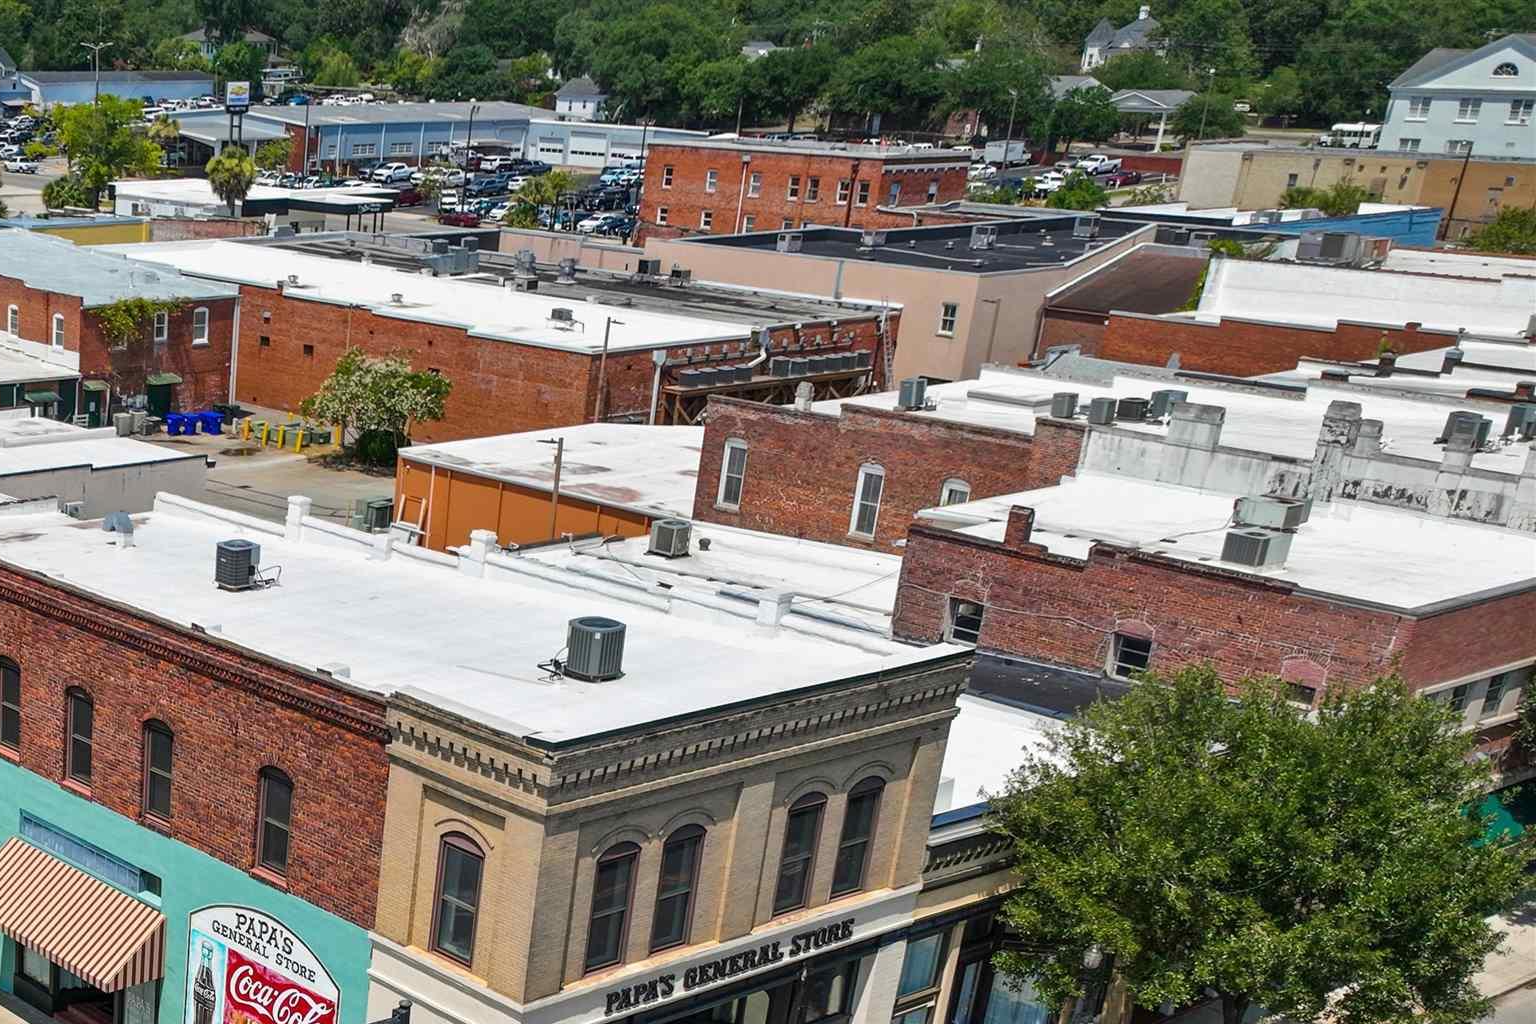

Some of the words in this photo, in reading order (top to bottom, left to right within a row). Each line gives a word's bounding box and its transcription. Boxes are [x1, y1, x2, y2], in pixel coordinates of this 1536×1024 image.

[211, 919, 269, 959] GENERAL
[275, 953, 317, 984] STORE
[235, 912, 294, 956] PAPA'S
[604, 973, 675, 1016] PAPA'S
[683, 940, 785, 992] GENERAL
[789, 918, 856, 957] STORE
